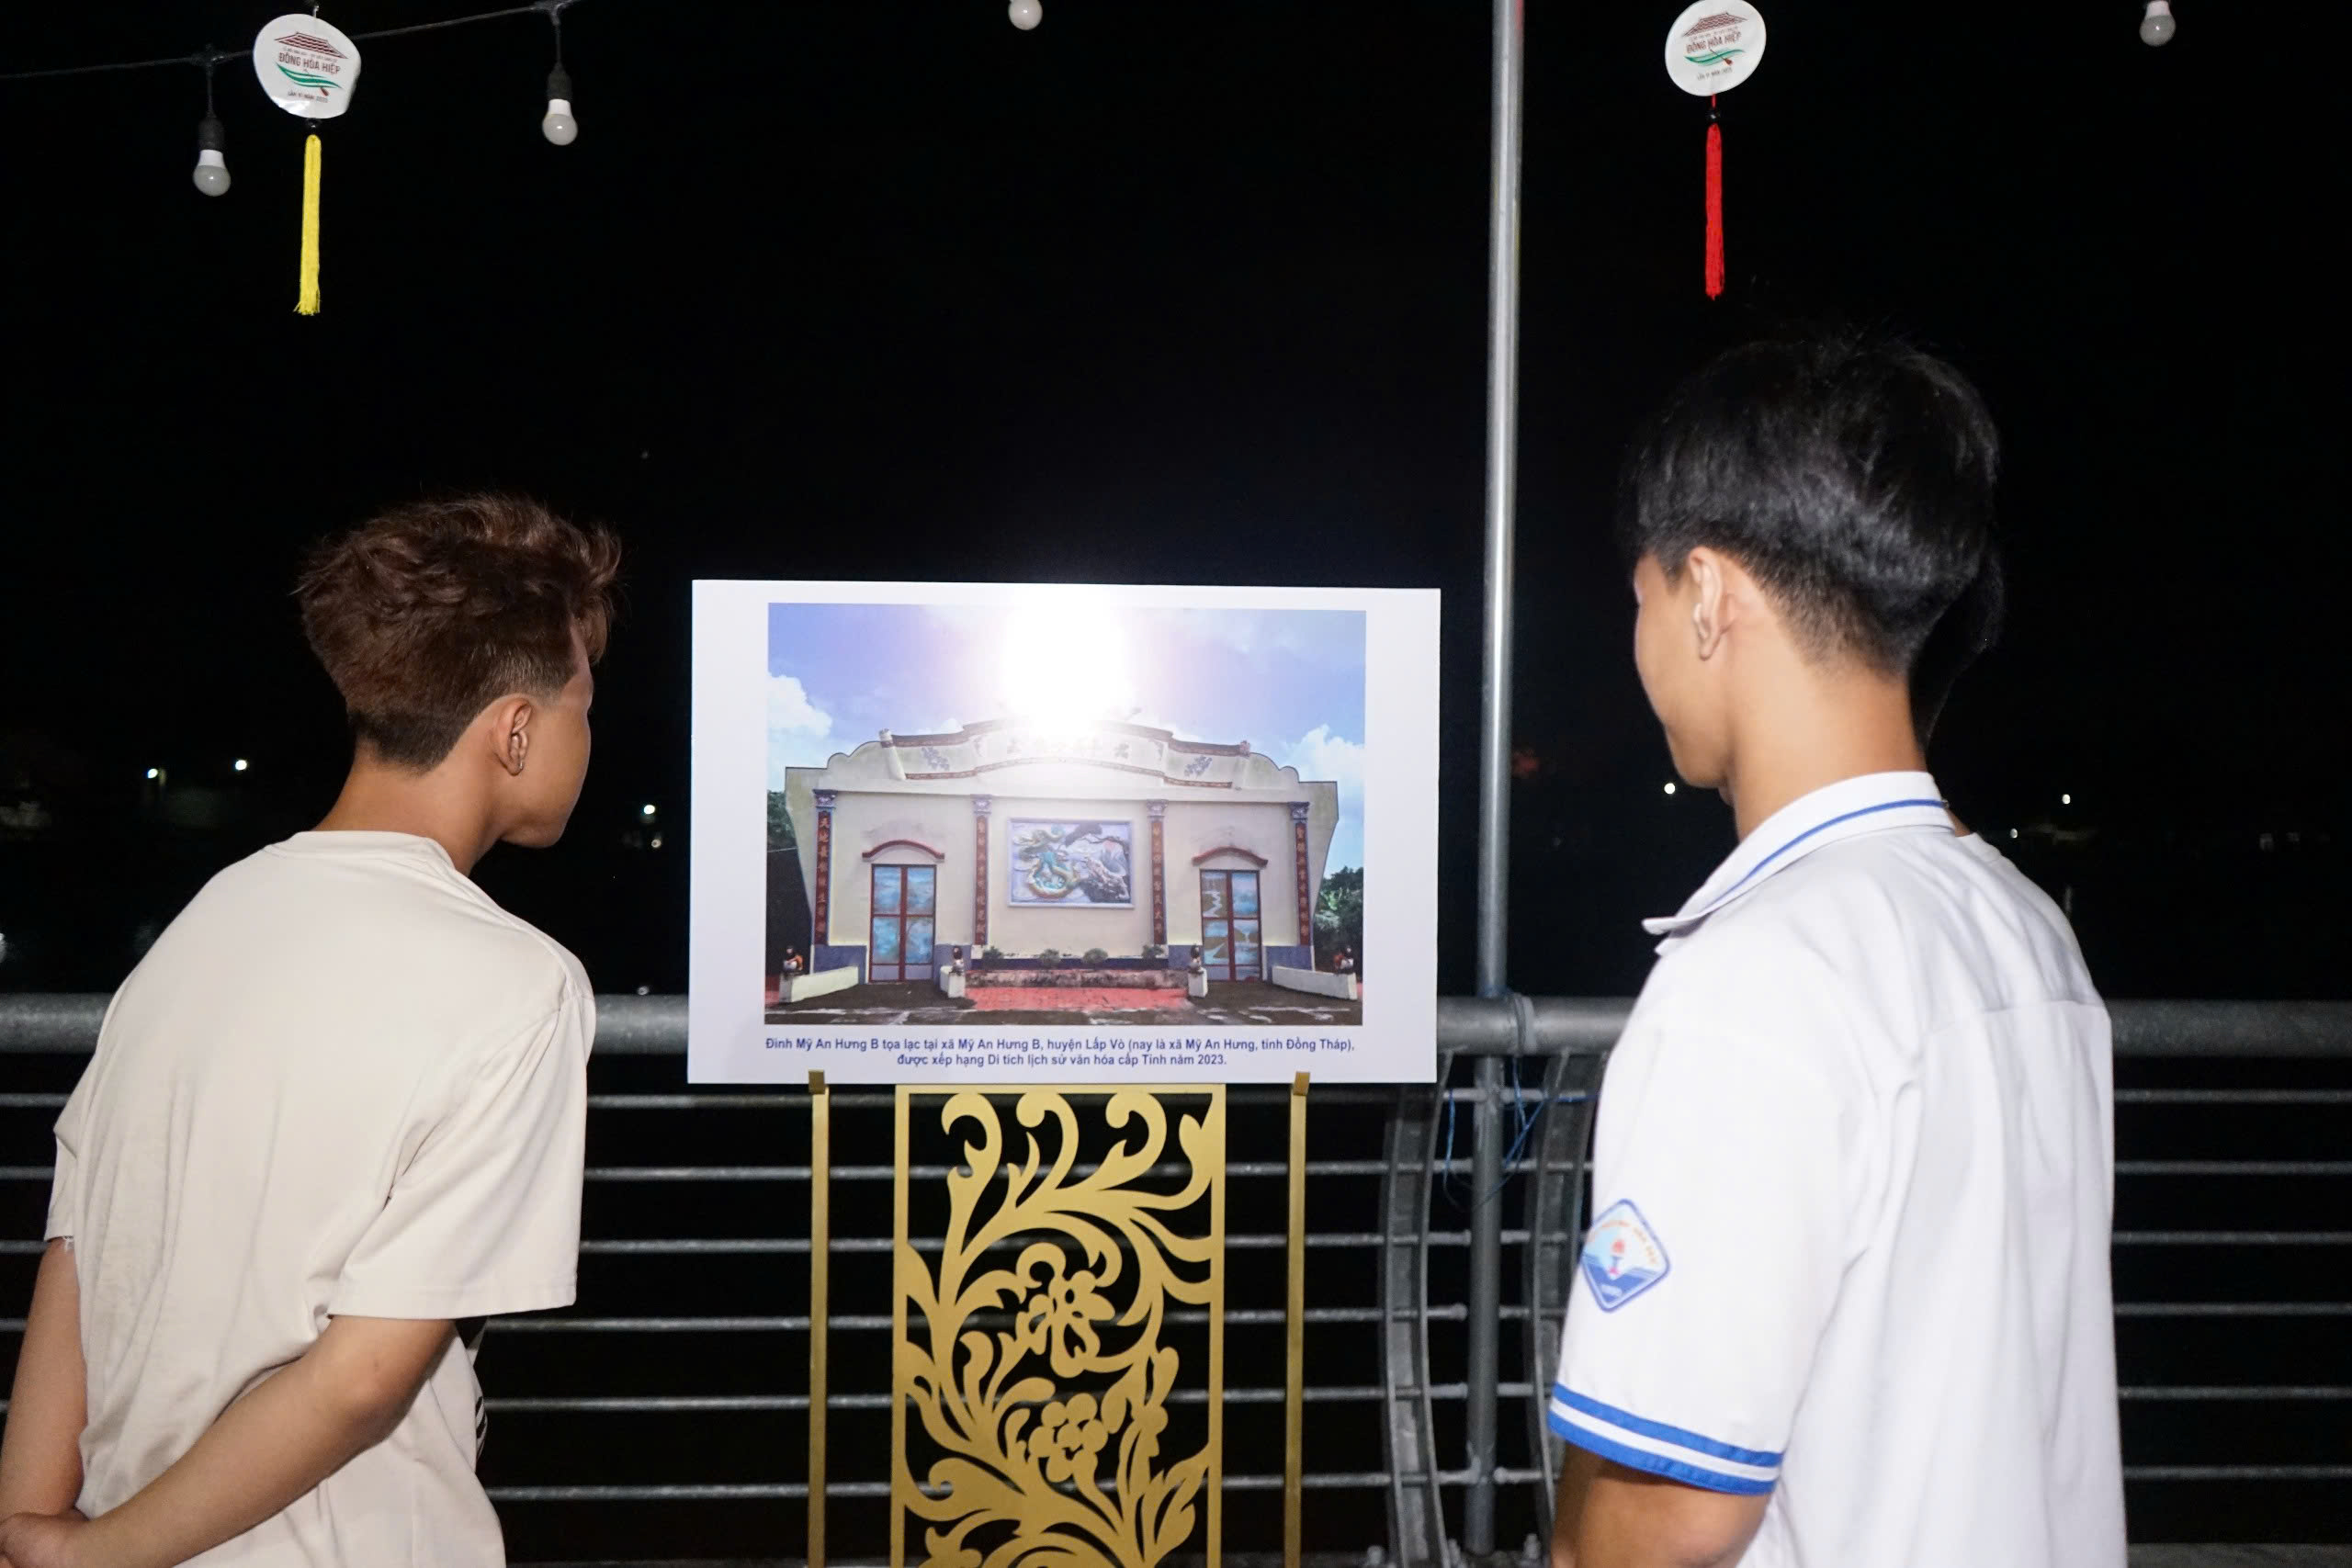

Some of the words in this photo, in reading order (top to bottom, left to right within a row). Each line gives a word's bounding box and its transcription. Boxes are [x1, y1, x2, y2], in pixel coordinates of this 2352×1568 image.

[322, 62, 341, 74] HIỆP
[796, 1038, 813, 1051] Mỹ
[816, 1038, 831, 1049] An
[835, 1039, 867, 1052] Hưng
[871, 1039, 879, 1049] B
[882, 1039, 900, 1052] tọa
[904, 1039, 921, 1052] lạc
[924, 1039, 938, 1052] tại
[941, 1040, 955, 1049] xã
[958, 1039, 974, 1052] Mỹ
[978, 1039, 993, 1049] An
[997, 1039, 1028, 1052] Hưng
[1033, 1039, 1044, 1051] B,
[1047, 1039, 1082, 1053] huyện
[1086, 1036, 1106, 1052] Lấp
[1128, 1039, 1152, 1052] (nay
[1156, 1039, 1165, 1049] là
[1169, 1040, 1182, 1049] xã
[1185, 1039, 1202, 1052] Mỹ
[1204, 1039, 1220, 1049] An
[1224, 1039, 1258, 1052] Hưng,
[1261, 1038, 1283, 1049] tỉnh
[1286, 1036, 1316, 1052] Đồng
[1319, 1039, 1354, 1052] Tháp),
[898, 1054, 928, 1066] được
[932, 1052, 952, 1067] xếp
[956, 1055, 984, 1067] hạng
[989, 1055, 1000, 1065] Di
[1003, 1055, 1023, 1065] tích
[1027, 1055, 1047, 1067] lịch
[1051, 1054, 1068, 1065] sử
[1070, 1055, 1091, 1065] văn
[1094, 1055, 1114, 1065] hóa
[1118, 1051, 1139, 1067] cấp
[1143, 1054, 1167, 1065] Tỉnh
[1170, 1055, 1194, 1065] năm
[1198, 1055, 1227, 1065] 2023.
